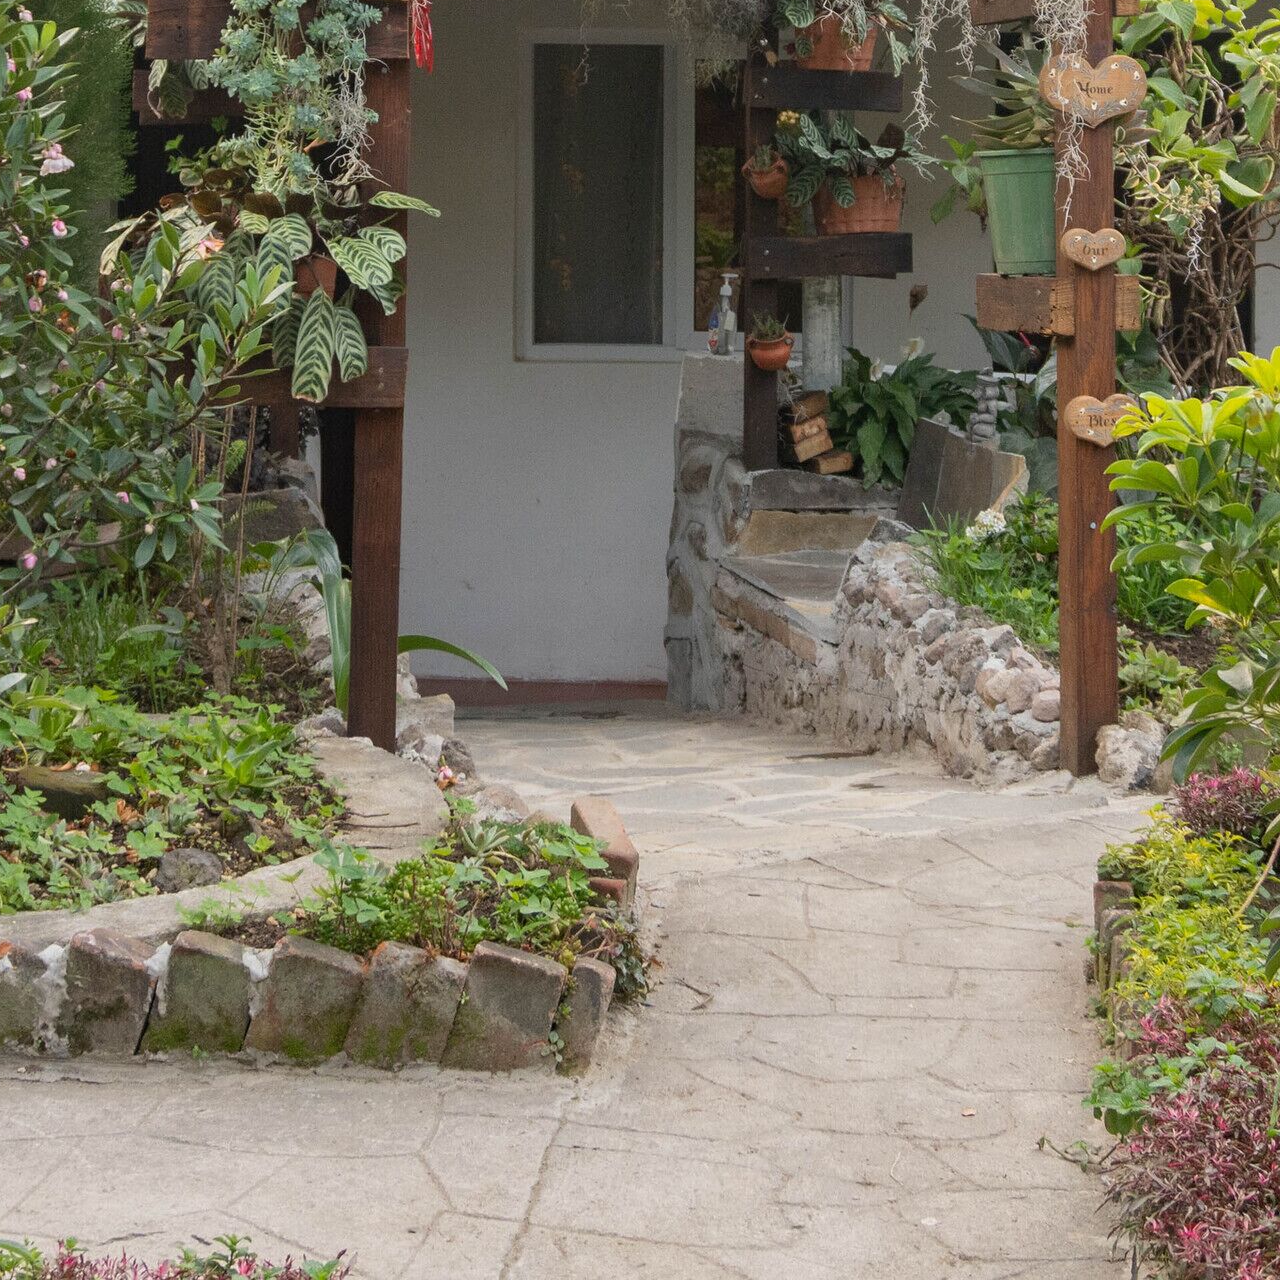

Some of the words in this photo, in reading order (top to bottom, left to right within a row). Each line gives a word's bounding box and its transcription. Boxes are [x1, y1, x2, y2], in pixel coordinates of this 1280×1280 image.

[1076, 81, 1114, 98] Home
[1083, 244, 1109, 256] Our
[1088, 414, 1119, 428] Bles
